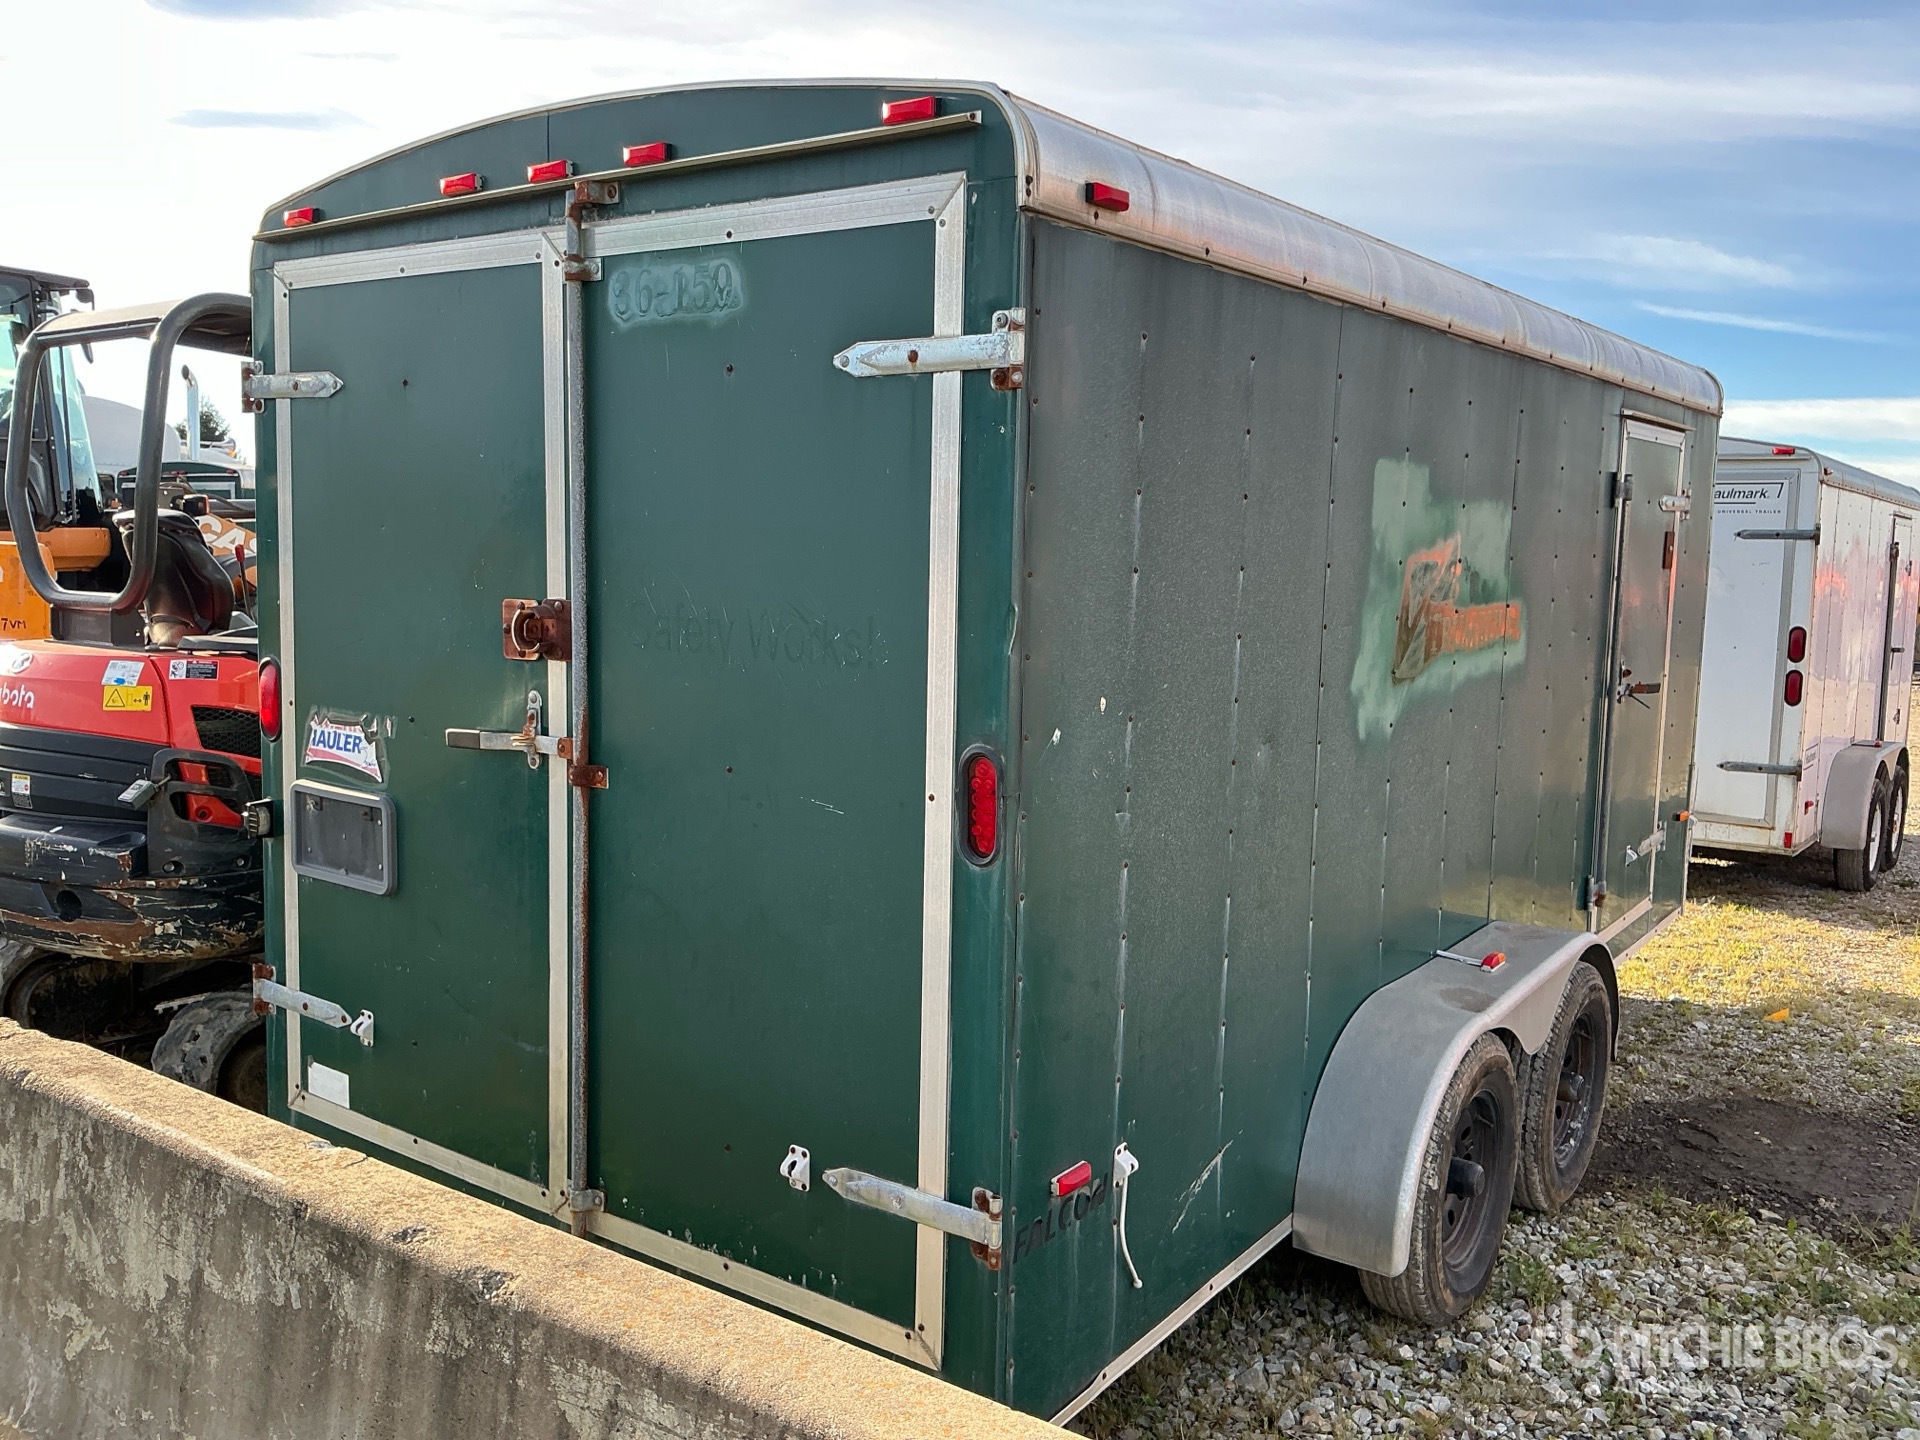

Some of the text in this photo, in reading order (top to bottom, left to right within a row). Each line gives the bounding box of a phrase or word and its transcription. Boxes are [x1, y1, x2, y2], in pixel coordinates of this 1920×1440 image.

[1714, 487, 1768, 499] aulmark
[194, 515, 257, 555] CA
[0, 682, 35, 709] bota
